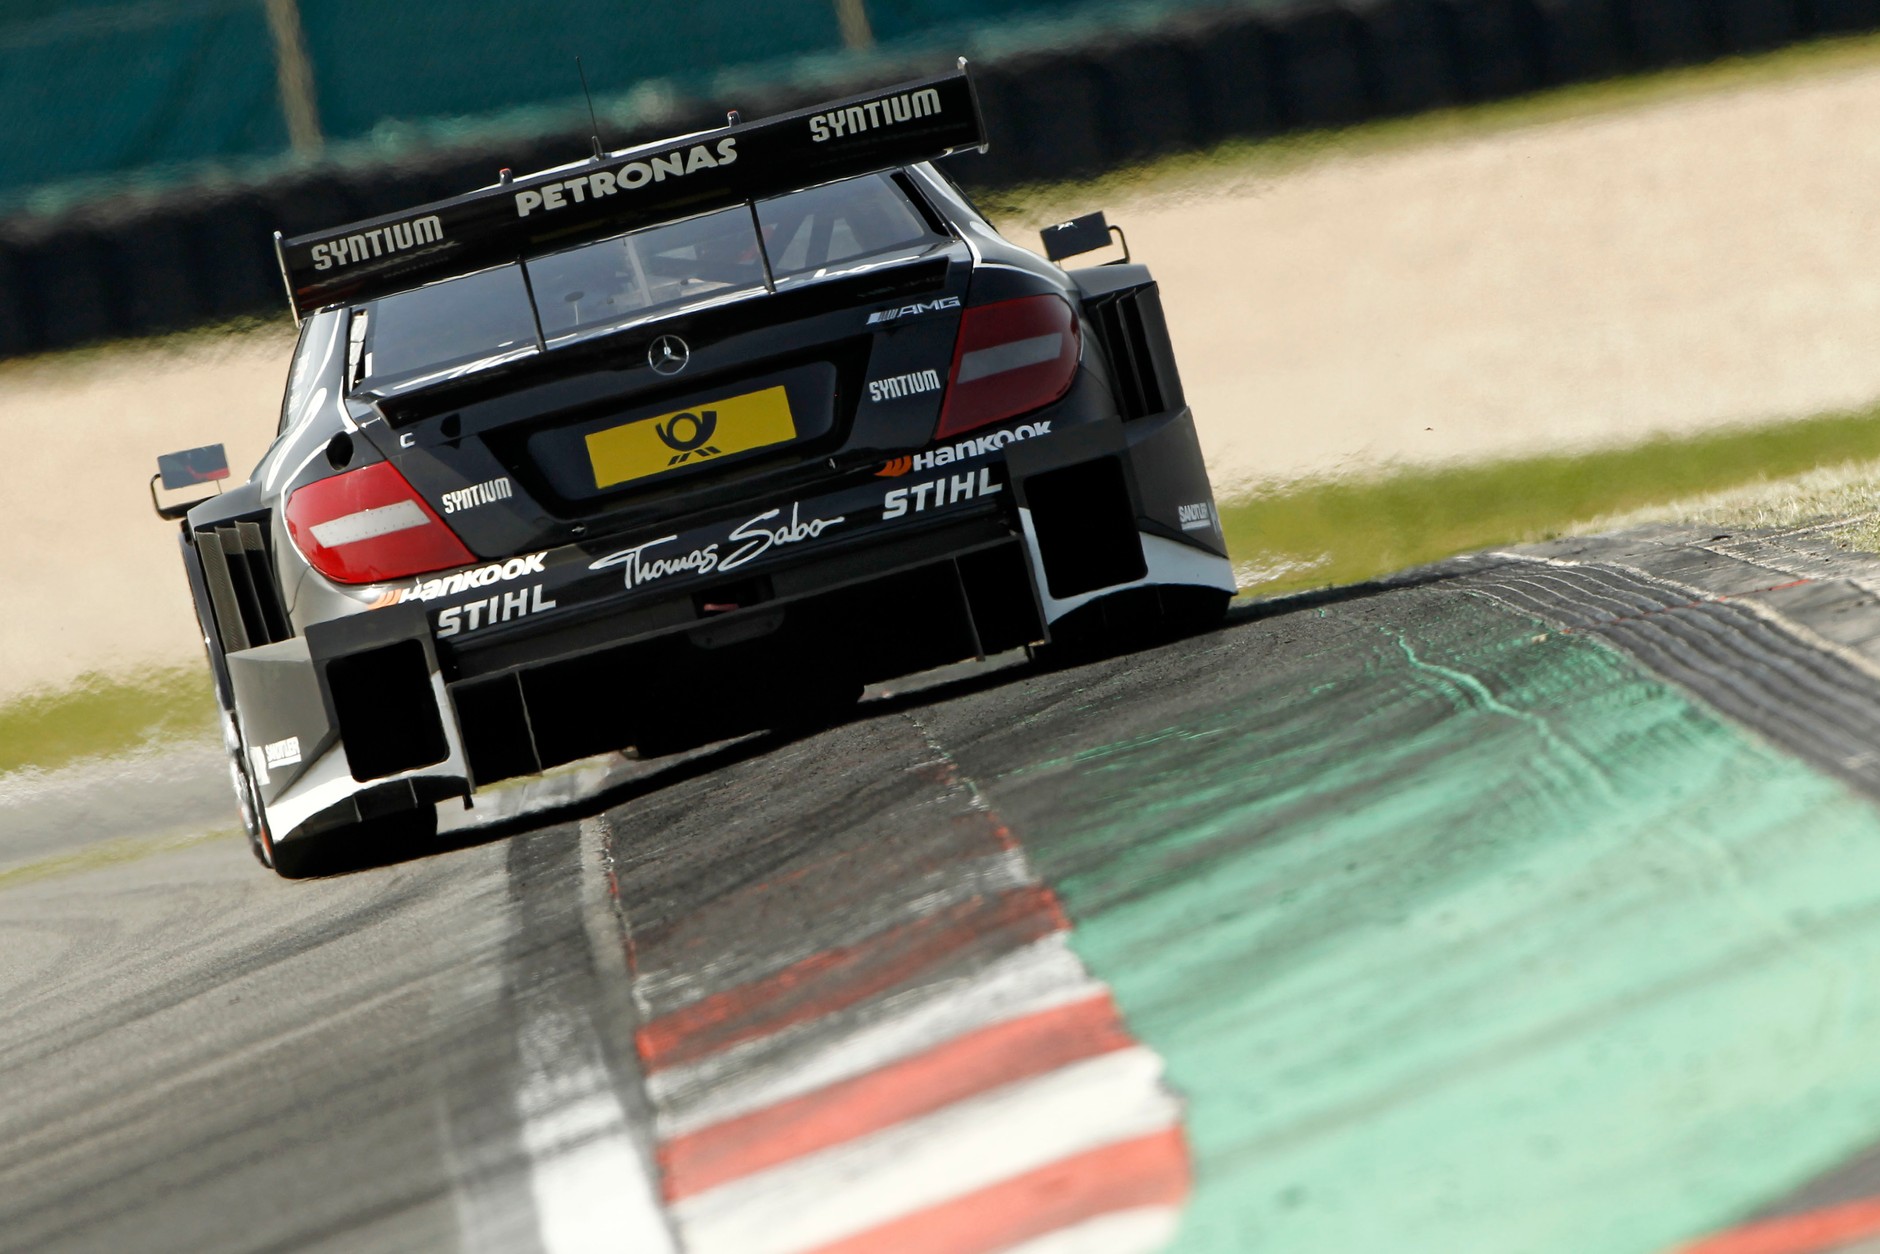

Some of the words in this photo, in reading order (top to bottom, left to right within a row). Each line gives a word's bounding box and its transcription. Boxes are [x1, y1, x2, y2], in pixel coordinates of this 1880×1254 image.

[809, 88, 942, 142] SYNTIUM
[514, 137, 738, 217] PETRONAS
[311, 215, 444, 271] SYNTIUM
[897, 296, 961, 318] AMG
[868, 369, 941, 402] SYNTIUM
[441, 477, 513, 514] SYNTIUM
[882, 467, 1003, 520] STIHL
[588, 535, 722, 589] Thomas
[717, 501, 845, 572] Sabo
[437, 584, 557, 639] STIHL
